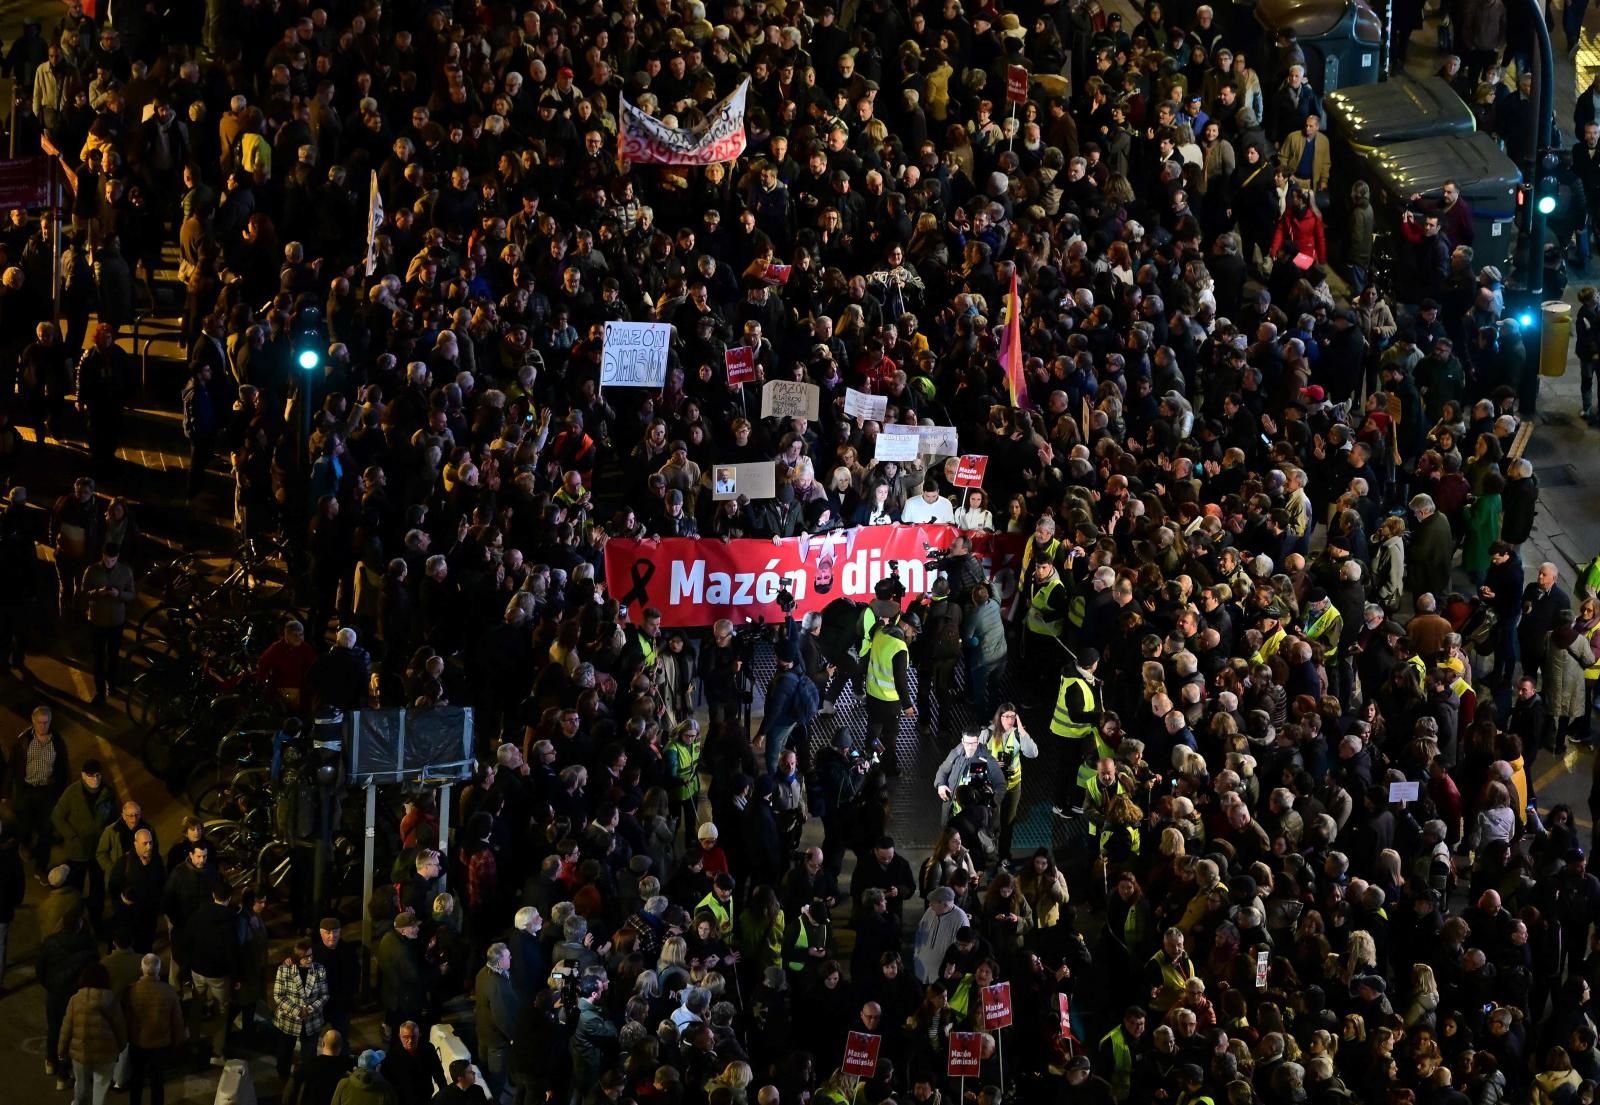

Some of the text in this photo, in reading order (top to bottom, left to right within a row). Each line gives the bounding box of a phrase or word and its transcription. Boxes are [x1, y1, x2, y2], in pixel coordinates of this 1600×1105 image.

[611, 324, 665, 348] MAZÓN
[959, 466, 977, 475] Mazón
[669, 558, 807, 606] Mazón
[985, 1002, 1004, 1012] Mazón
[847, 1049, 869, 1059] Mazón
[951, 1049, 972, 1058] Mazón
[846, 1057, 875, 1068] dimissió
[950, 1057, 978, 1066] dimissió
